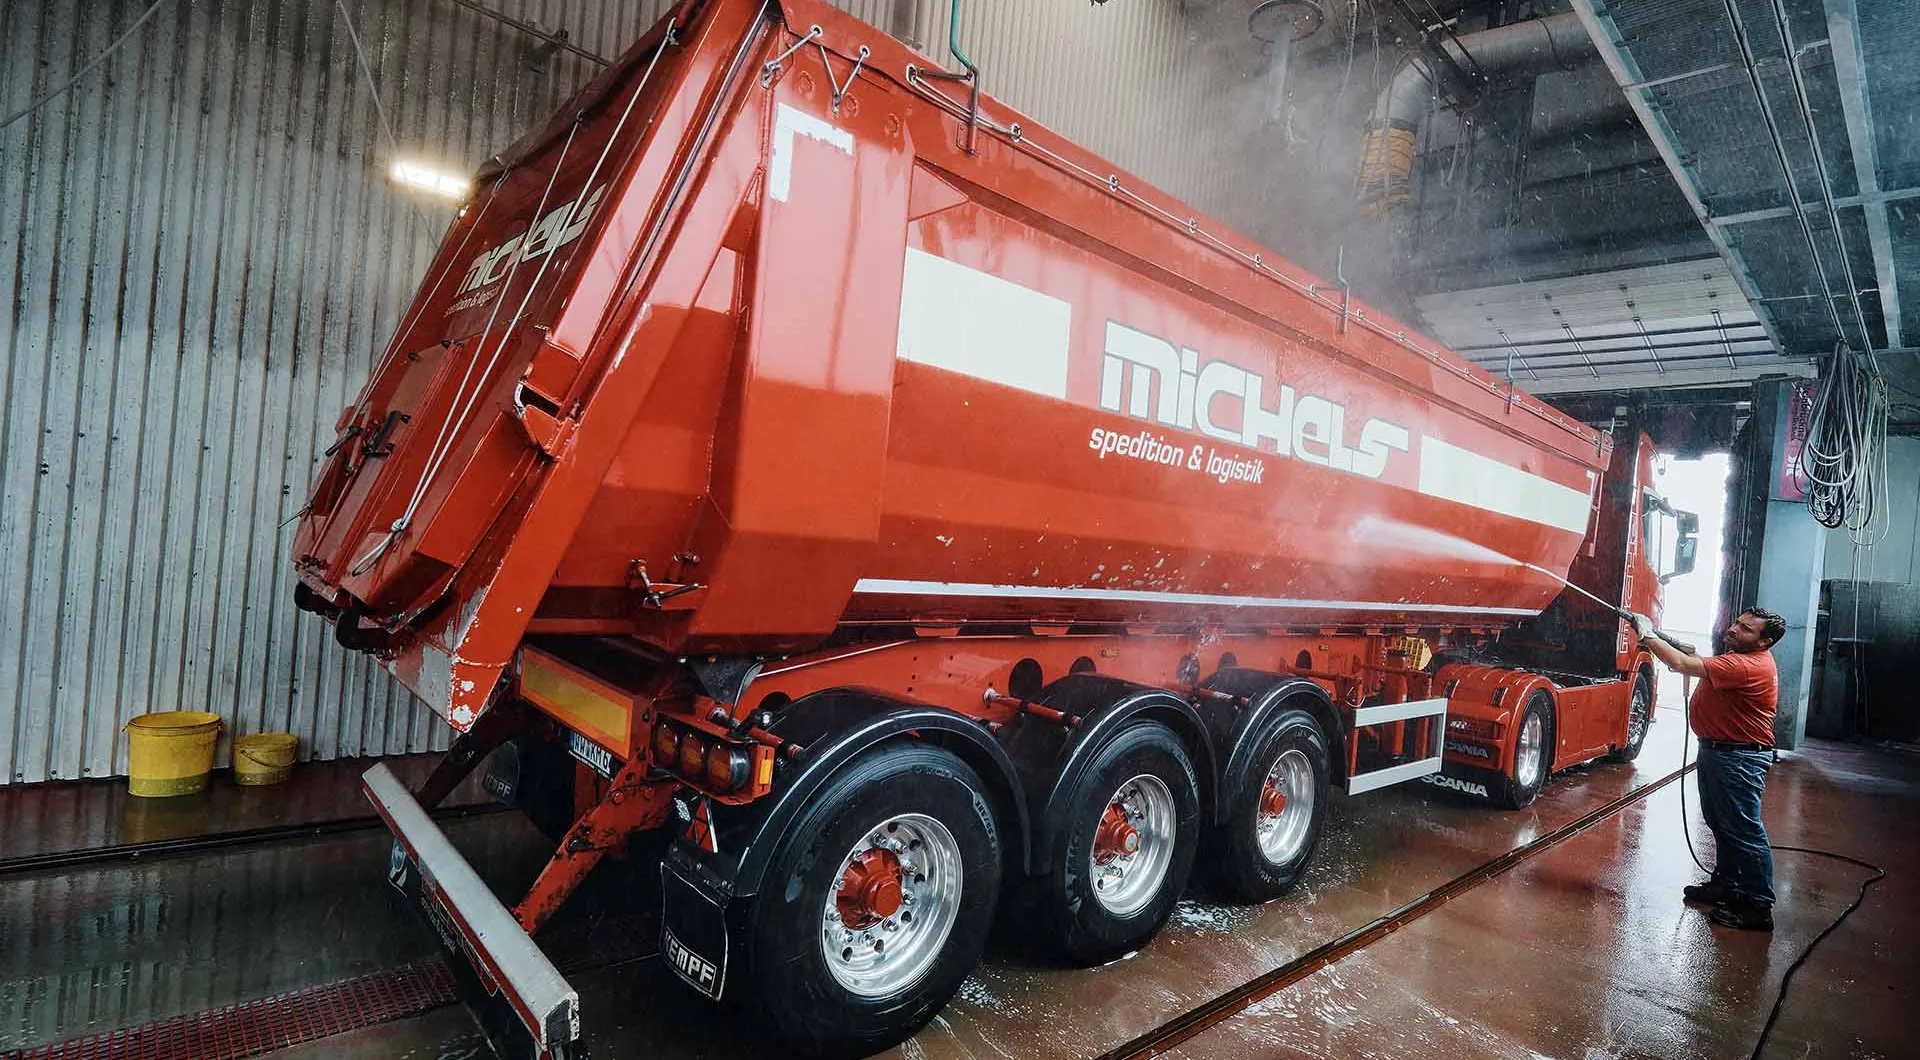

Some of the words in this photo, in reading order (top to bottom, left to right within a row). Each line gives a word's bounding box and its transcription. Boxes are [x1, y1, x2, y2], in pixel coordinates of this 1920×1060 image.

[1089, 428, 1184, 467] spedition
[1187, 445, 1203, 470] &
[1205, 449, 1264, 484] logistik
[1445, 741, 1488, 759] CANIA
[1420, 774, 1488, 798] SCANIA
[664, 930, 715, 983] KEMPF
